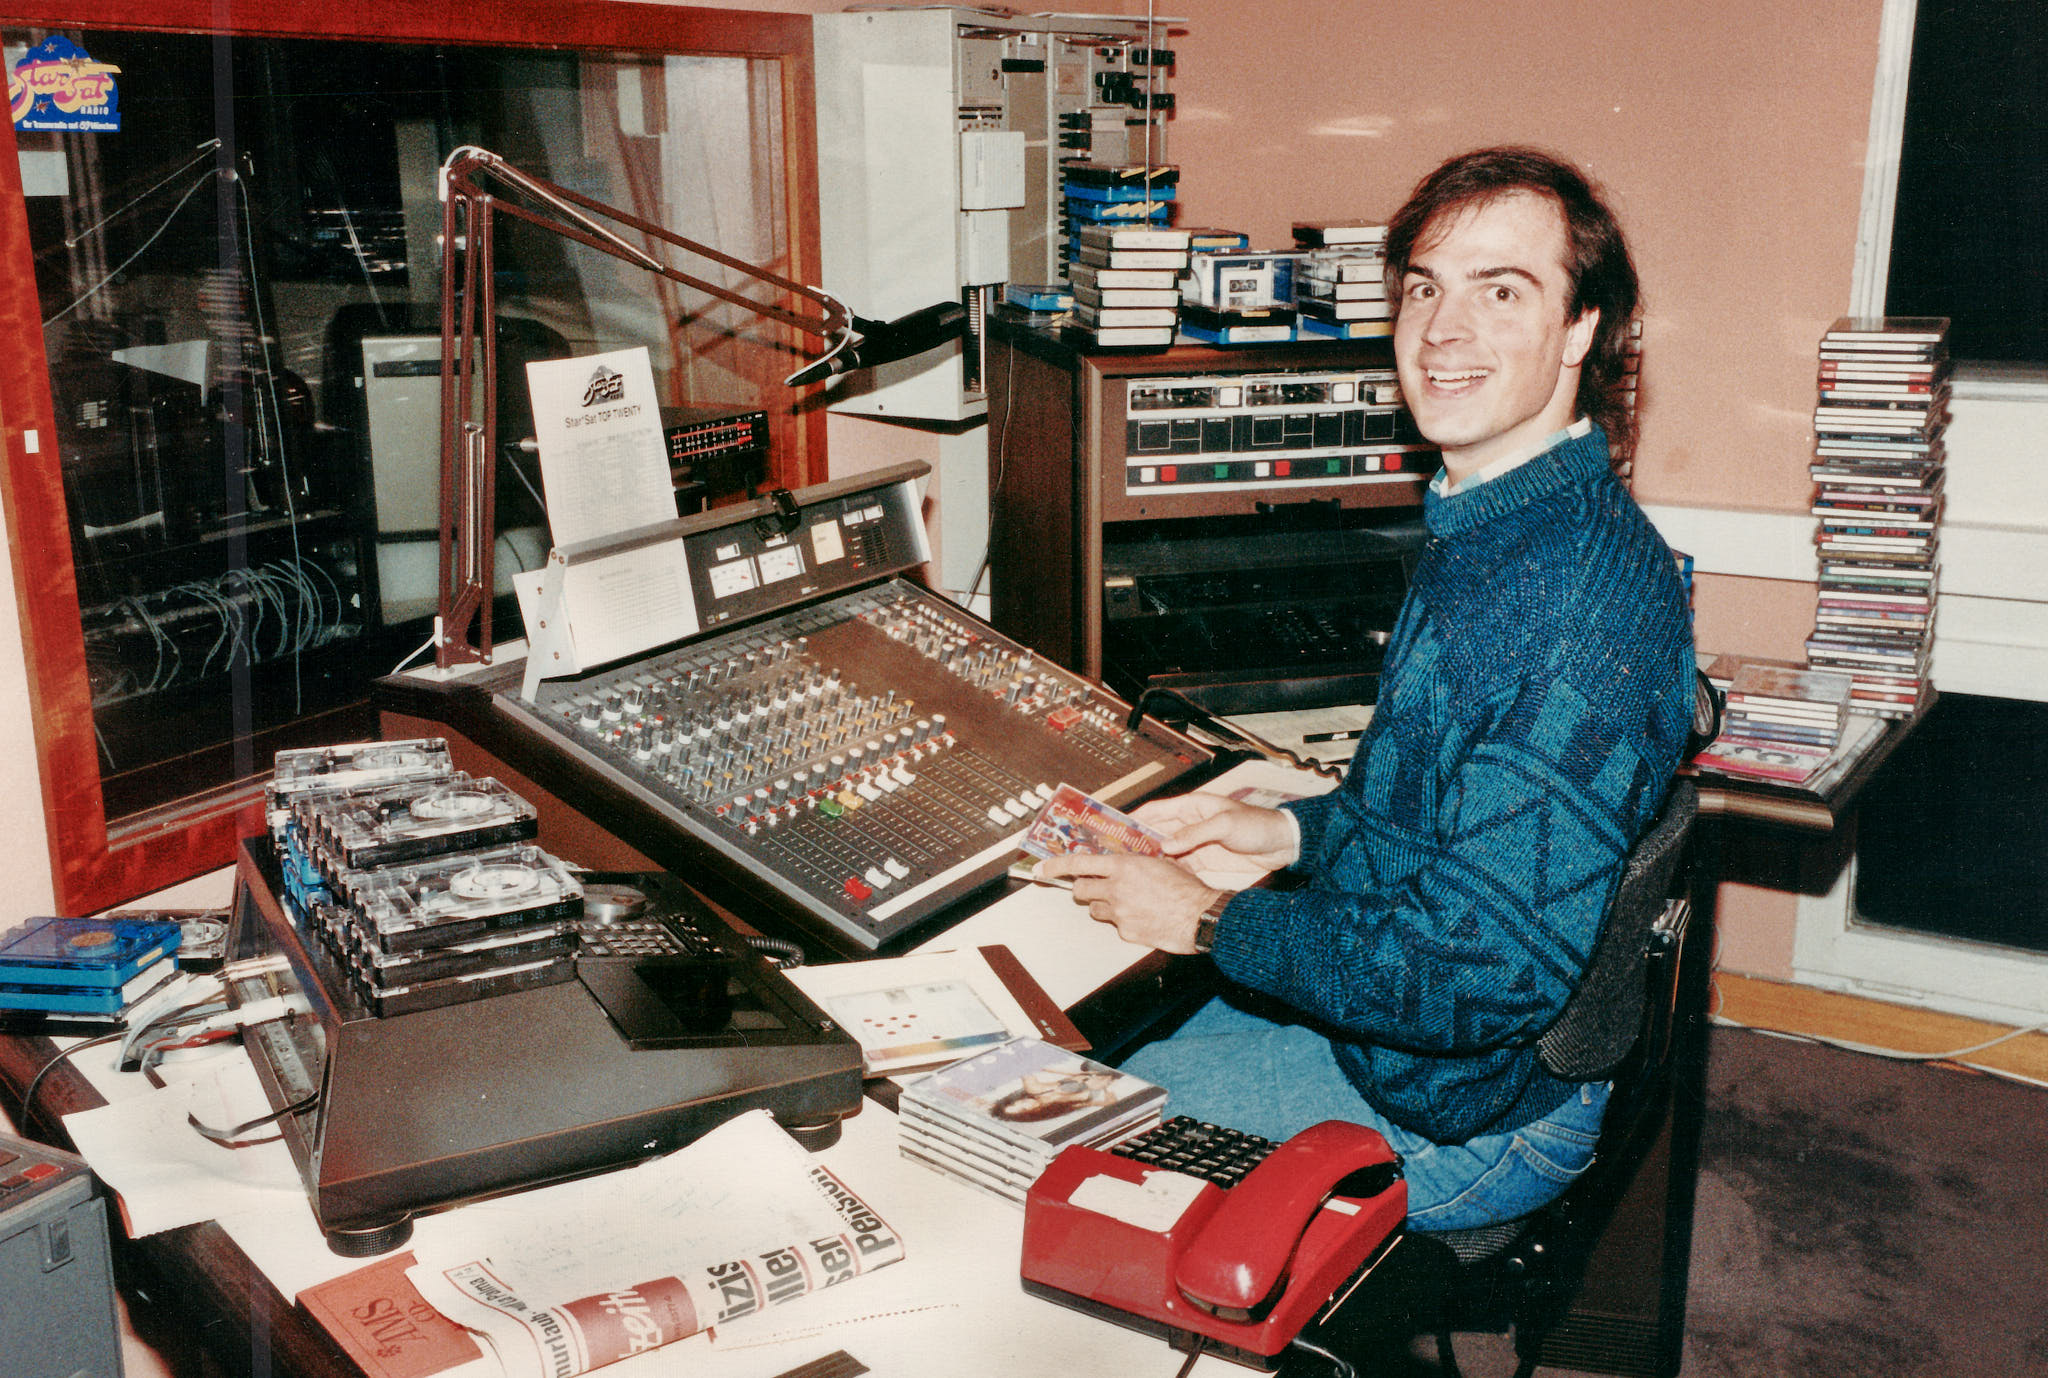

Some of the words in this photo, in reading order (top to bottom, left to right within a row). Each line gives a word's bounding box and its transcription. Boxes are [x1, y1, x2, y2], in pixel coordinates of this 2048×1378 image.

[80, 106, 109, 115] RADIO
[598, 409, 612, 422] TOP
[612, 404, 642, 419] TWENTY
